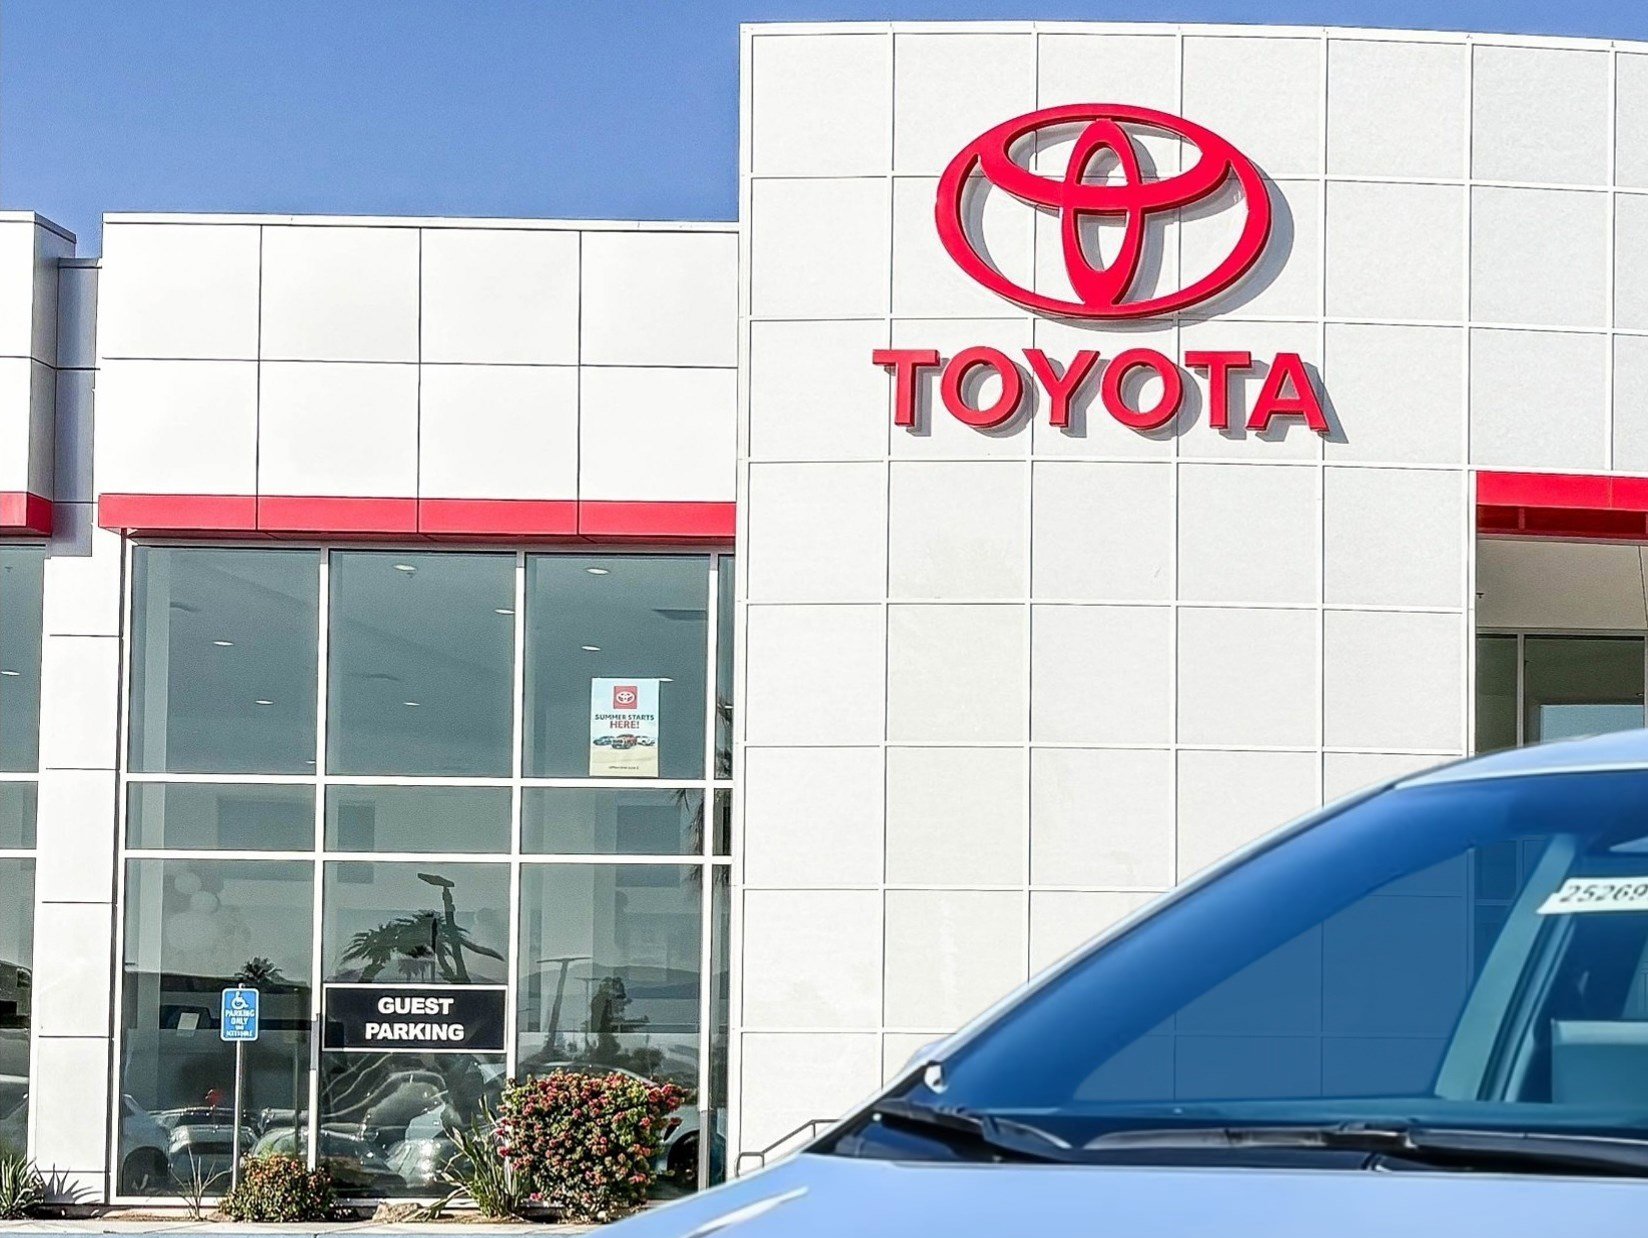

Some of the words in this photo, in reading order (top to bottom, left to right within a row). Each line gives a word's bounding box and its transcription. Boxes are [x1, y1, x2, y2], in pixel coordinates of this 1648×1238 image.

[872, 346, 1329, 432] TOYOTA
[609, 721, 640, 729] HERE!
[377, 996, 455, 1015] GUEST
[364, 1022, 465, 1041] PARKING
